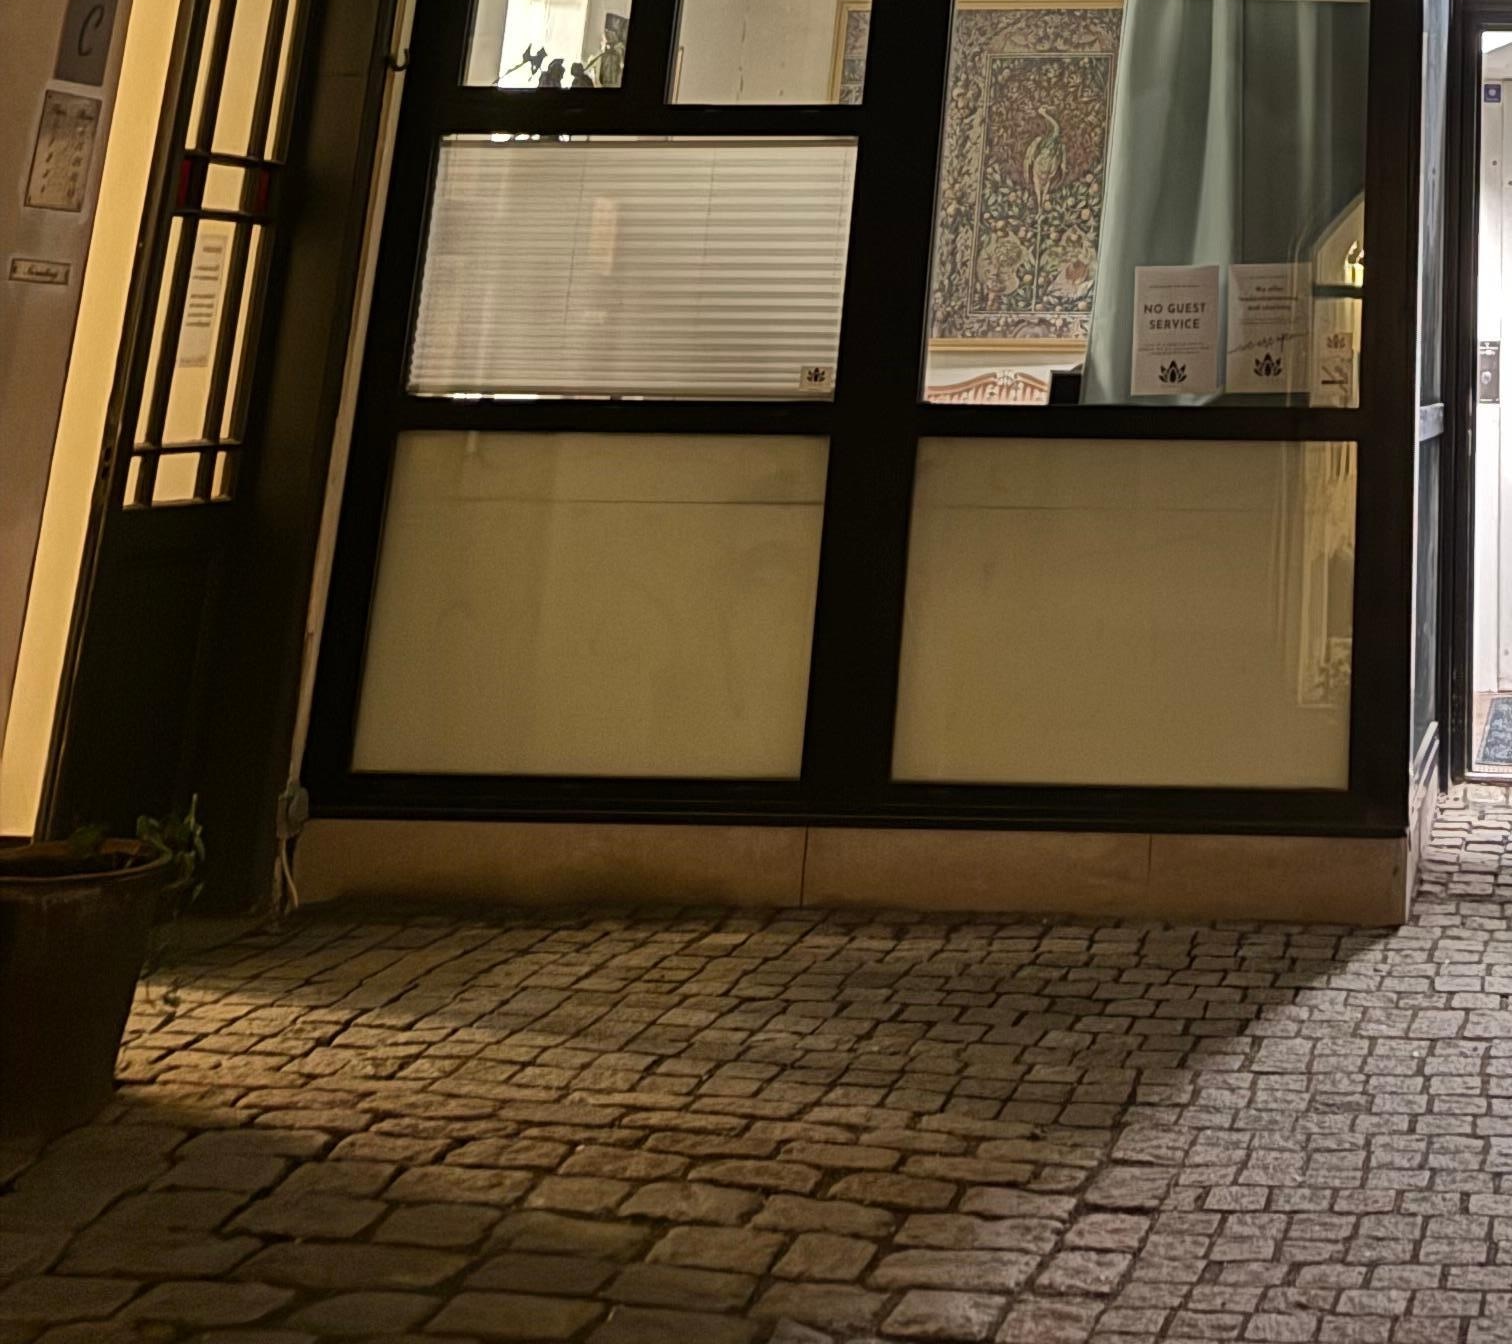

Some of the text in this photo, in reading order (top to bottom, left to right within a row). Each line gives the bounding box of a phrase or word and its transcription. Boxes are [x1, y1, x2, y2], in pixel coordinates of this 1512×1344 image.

[77, 3, 106, 57] C
[1143, 302, 1207, 314] NO GUEST
[1149, 318, 1201, 330] SERVICE
